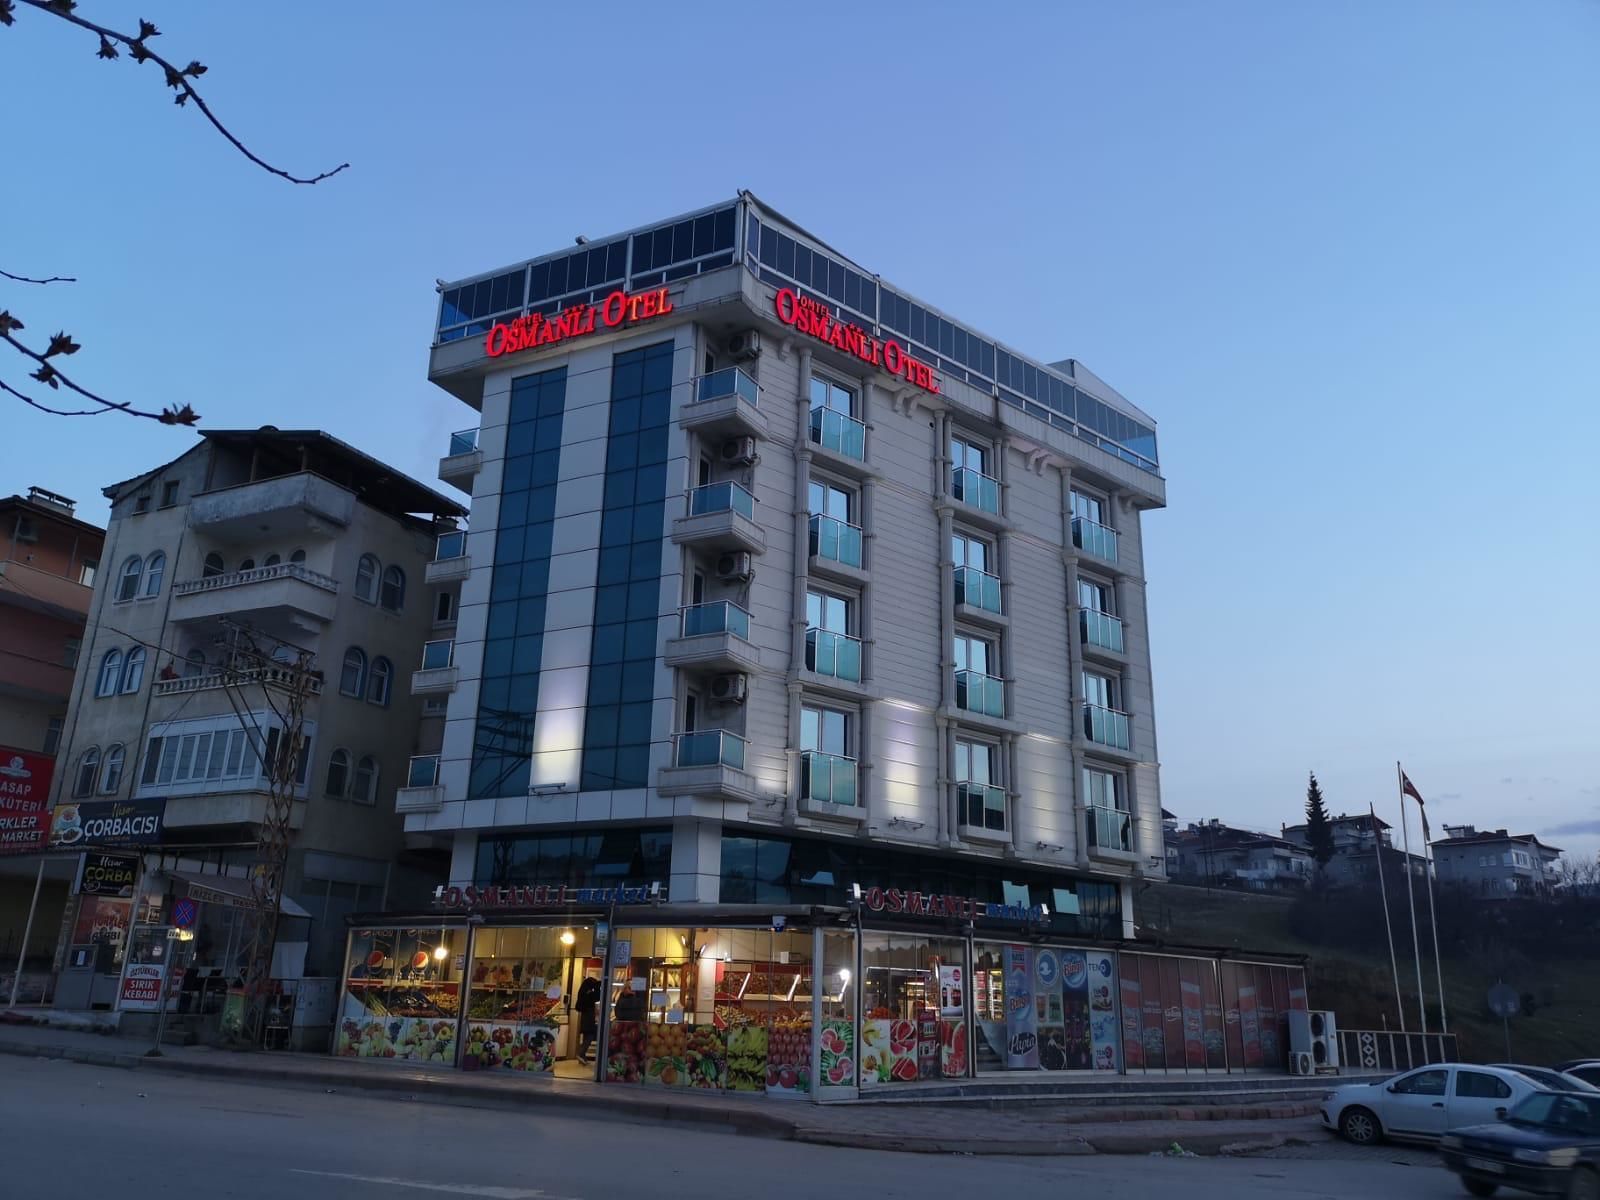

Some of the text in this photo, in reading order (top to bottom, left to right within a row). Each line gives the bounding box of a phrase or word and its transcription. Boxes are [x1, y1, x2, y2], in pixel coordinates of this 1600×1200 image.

[486, 287, 673, 357] OSMANLI OTEL
[775, 288, 940, 394] OSMANLI OTEL
[2, 831, 44, 842] MARKET
[84, 816, 160, 842] ÇORBACISI
[86, 865, 134, 883] ÇORBA
[446, 884, 567, 907] OSMANLI
[866, 886, 978, 921] OSMANLI
[124, 989, 157, 1001] KEBABI
